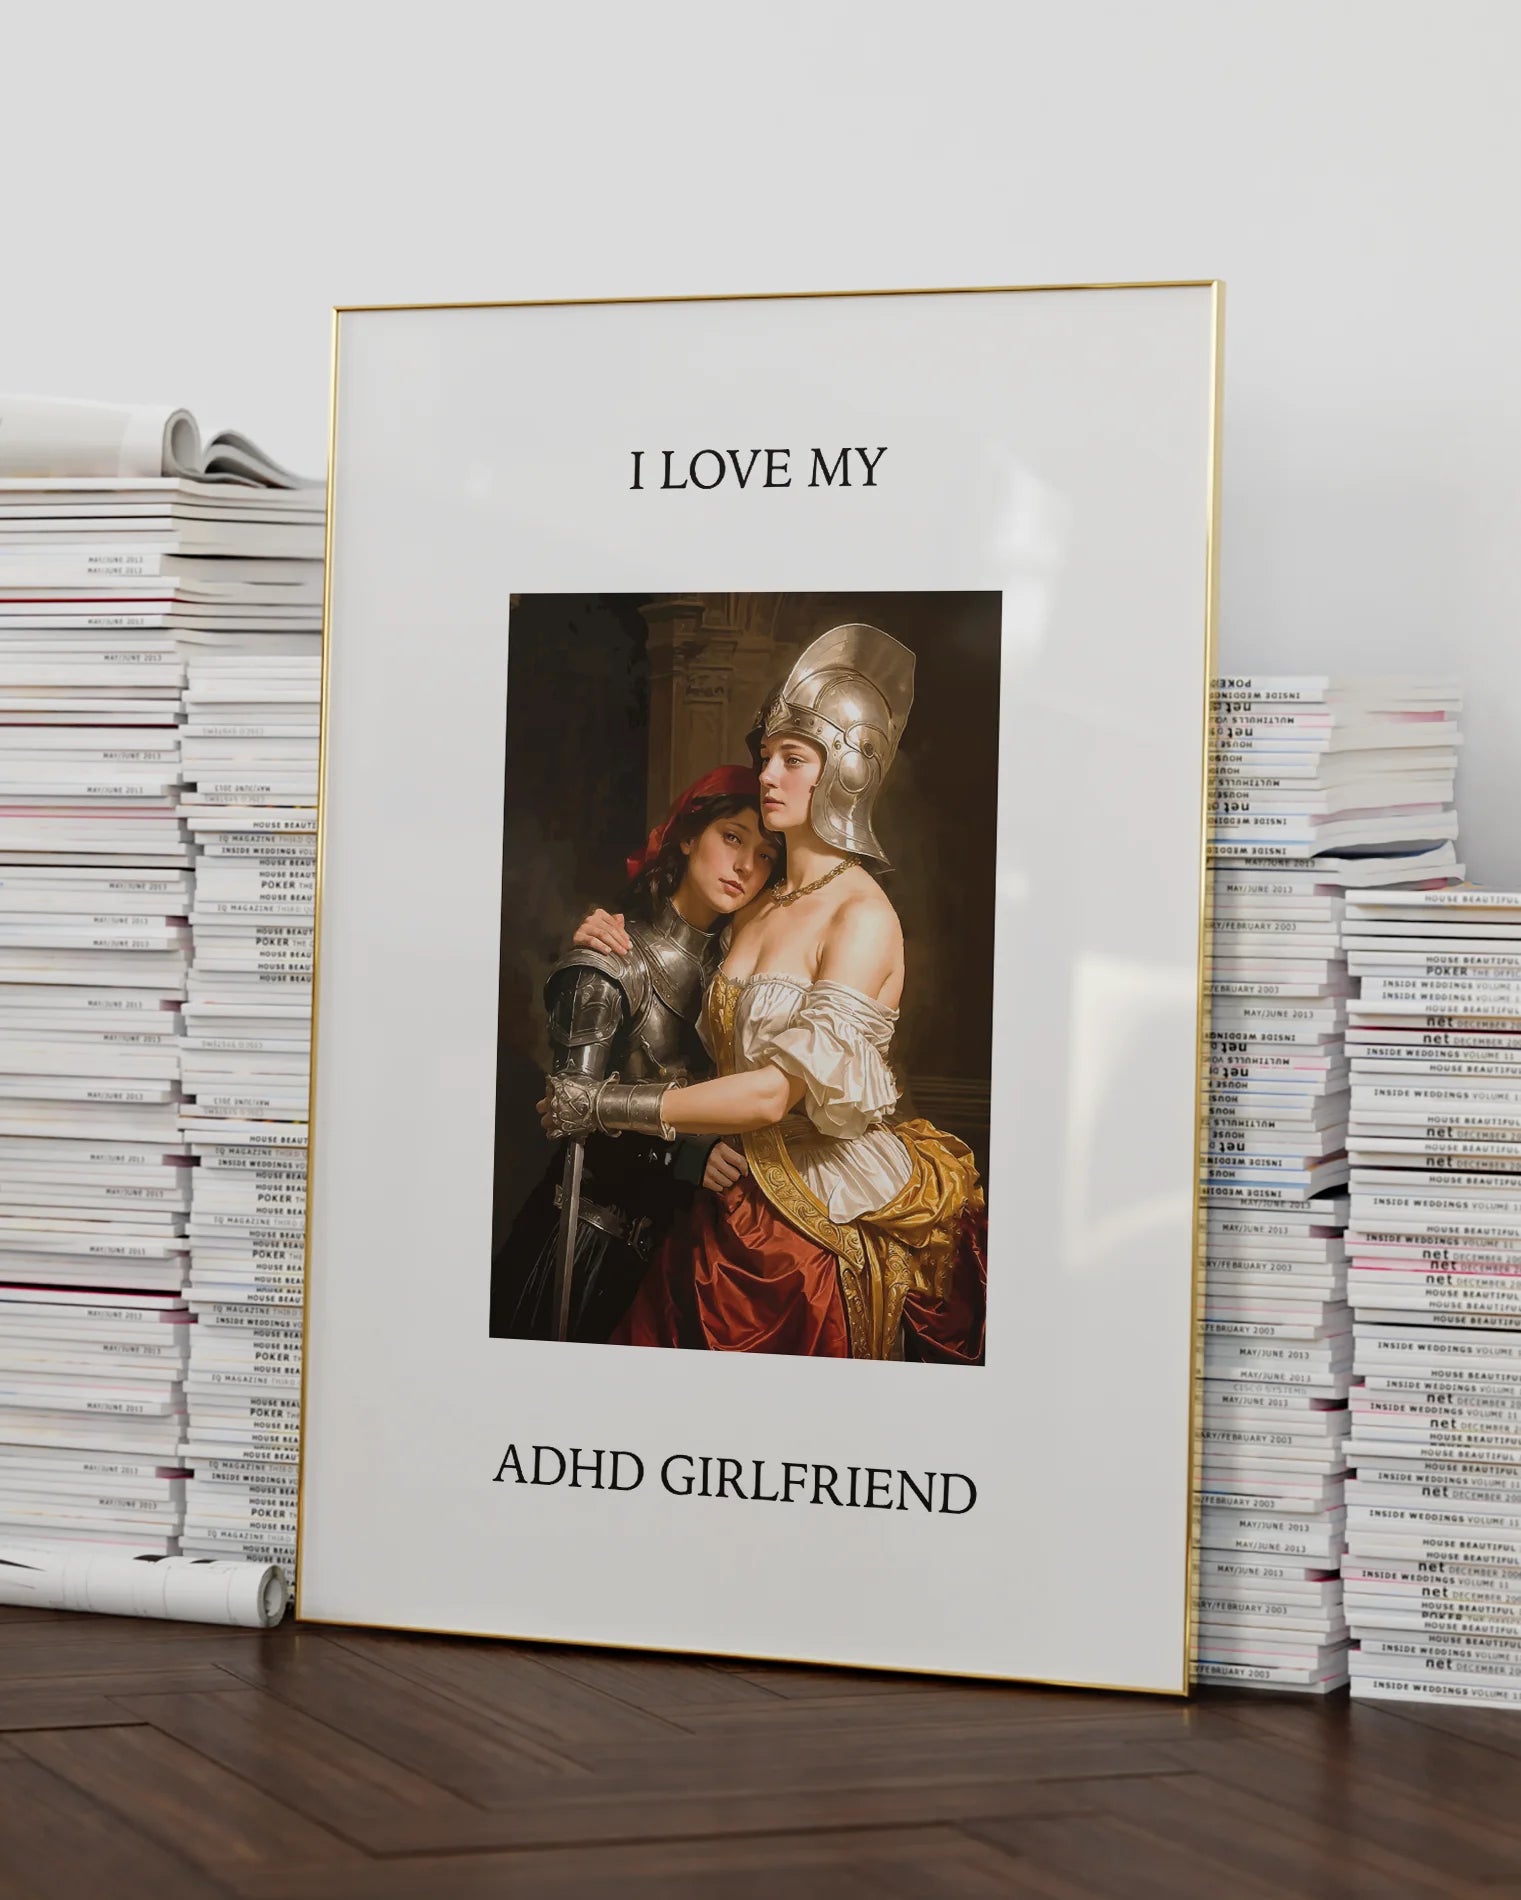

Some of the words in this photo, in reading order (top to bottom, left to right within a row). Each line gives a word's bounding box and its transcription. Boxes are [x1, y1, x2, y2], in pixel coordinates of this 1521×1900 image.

[630, 452, 644, 489] I
[661, 449, 791, 489] LOVE
[808, 447, 887, 487] MY
[1219, 680, 1251, 688] POKE
[1226, 702, 1251, 712] net
[1228, 728, 1252, 738] net
[262, 881, 296, 889] POKER
[1272, 886, 1293, 894] 2013
[1426, 966, 1468, 976] POKER
[1494, 970, 1521, 978] OFFIC
[1383, 980, 1416, 988] INSIDE
[1420, 981, 1472, 989] WEDDINGS
[1244, 1010, 1288, 1018] MAY/JUNE
[1210, 1032, 1256, 1040] WEDDING
[1424, 1034, 1450, 1044] net
[1454, 1038, 1503, 1046] DECEMBER
[1222, 1043, 1247, 1054] net
[1366, 1048, 1402, 1056] INSIDE
[1406, 1049, 1460, 1058] WEDDINGS
[1464, 1051, 1500, 1059] VOLUME
[1228, 1056, 1290, 1064] MULTIHULLS
[1214, 1120, 1275, 1128] MULTIHULLS
[1428, 1116, 1460, 1124] HOUSE
[1464, 1118, 1520, 1126] BEAUTIFUL
[1426, 1126, 1453, 1137] net
[1457, 1130, 1506, 1139] DECEMBER
[1220, 1142, 1245, 1152] net
[250, 1160, 292, 1168] WEDDINGS
[1208, 1157, 1245, 1166] WEDDIN
[258, 1194, 292, 1202] POKER
[1223, 1224, 1264, 1232] MAY/JUNE
[1268, 1226, 1288, 1234] 2013
[1427, 1226, 1460, 1234] HOUSE
[1464, 1227, 1519, 1236] BEAUTIFUL
[1366, 1234, 1402, 1243] INSIDE
[1406, 1236, 1460, 1246] WEDDINGS
[1463, 1239, 1499, 1248] VOLUME
[252, 1250, 285, 1259] POKER
[1422, 1248, 1449, 1259] net
[1453, 1253, 1502, 1262] DECEMBER
[1270, 1263, 1292, 1272] 2003
[1463, 1291, 1518, 1300] BEAUTIFUL
[216, 1316, 243, 1324] INSIDE
[248, 1318, 290, 1327] WEDDINGS
[1240, 1349, 1283, 1357] MAY/JUNE
[1288, 1350, 1310, 1358] 2013
[225, 1376, 268, 1384] MAGAZINE
[1240, 1371, 1285, 1380] MAY/JUNE
[1289, 1373, 1312, 1382] 2013
[1222, 1396, 1265, 1405] MAY/JUNE
[1268, 1398, 1288, 1406] 2013
[1370, 1403, 1405, 1412] INSIDE
[1410, 1405, 1464, 1415] WEDDINGS
[1467, 1408, 1502, 1418] VOLUME
[1430, 1418, 1456, 1428] net
[1270, 1436, 1292, 1444] 2003
[1425, 1463, 1458, 1472] HOUSE
[1463, 1464, 1518, 1475] BEAUTIFUL
[212, 1472, 240, 1480] INSIDE
[244, 1474, 286, 1483] WEDDINGS
[493, 1444, 644, 1490] ADHD
[661, 1455, 977, 1514] GIRLFRIEND
[1378, 1472, 1412, 1482] INSIDE
[1416, 1474, 1468, 1484] WEDDINGS
[1472, 1478, 1507, 1488] VOLUME
[1422, 1486, 1448, 1497] net
[1452, 1490, 1501, 1501] DECEMBER
[252, 1508, 286, 1518] POKER
[1370, 1510, 1405, 1518] INSIDE
[1410, 1512, 1464, 1522] WEDDINGS
[1468, 1516, 1504, 1525] VOLUME
[1240, 1520, 1284, 1530] MAY/JUNE
[1288, 1522, 1310, 1532] 2013
[1423, 1539, 1456, 1548] HOUSE
[1460, 1541, 1516, 1551] BEAUTIFUL
[1427, 1552, 1459, 1560] HOUSE
[1464, 1554, 1519, 1564] BEAUTIFUL
[1218, 1565, 1259, 1574] MAY/JUNE
[1264, 1567, 1284, 1576] 2013
[1418, 1562, 1445, 1573] net
[1449, 1566, 1498, 1577] DECEMBER
[1362, 1570, 1396, 1579] INSIDE
[1402, 1573, 1455, 1584] WEDDINGS
[1459, 1578, 1494, 1588] VOLUME
[1422, 1602, 1454, 1610] HOUSE
[1458, 1604, 1514, 1615] BEAUTIFUL
